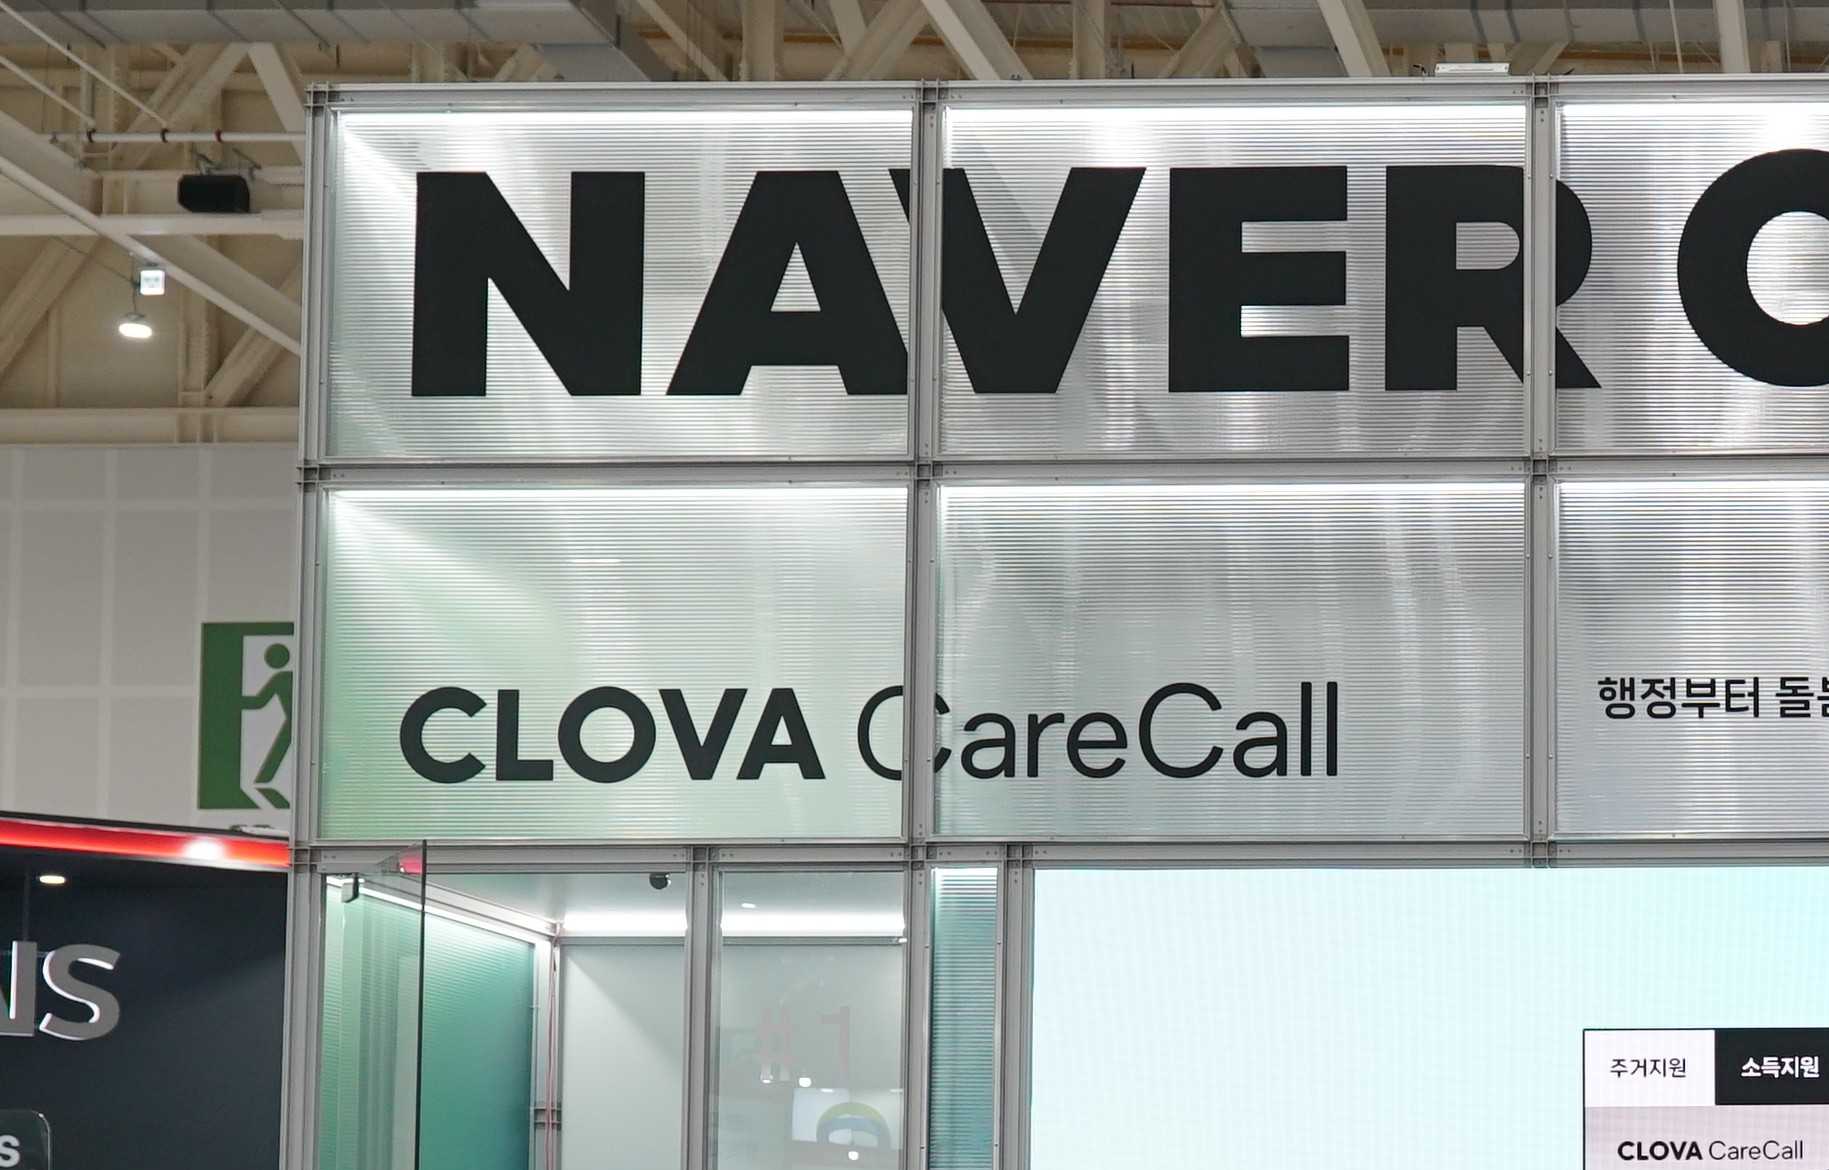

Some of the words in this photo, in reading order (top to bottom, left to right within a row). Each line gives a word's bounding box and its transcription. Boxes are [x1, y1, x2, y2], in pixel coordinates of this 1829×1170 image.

[411, 165, 1602, 396] NAVER
[1597, 676, 1759, 720] 행정부터
[399, 686, 825, 783] CLOVA
[857, 681, 1338, 781] CareCall
[1609, 1056, 1687, 1079] 주거지원
[1740, 1055, 1820, 1079] 소득지원
[1617, 1140, 1704, 1162] CLOVA
[1708, 1140, 1804, 1161] CareCall
